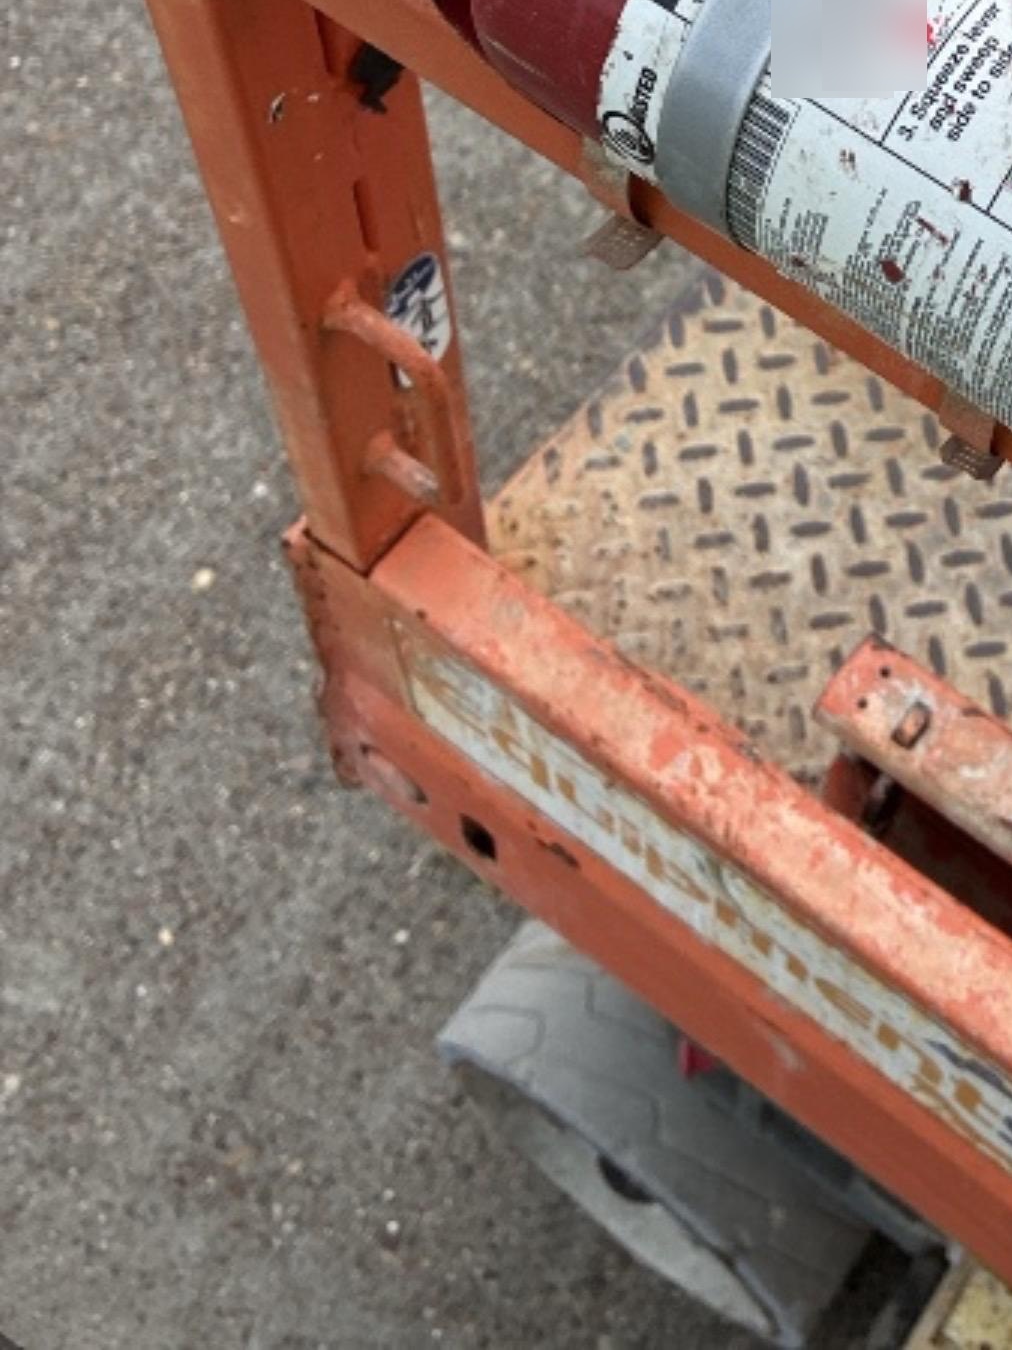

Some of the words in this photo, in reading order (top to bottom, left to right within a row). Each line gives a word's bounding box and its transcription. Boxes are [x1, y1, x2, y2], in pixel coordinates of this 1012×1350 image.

[895, 116, 919, 142] 3.
[908, 41, 974, 122] Squeeze
[963, 0, 1003, 44] lever
[925, 92, 959, 131] and
[951, 34, 1004, 96] sweep
[940, 98, 979, 142] side
[970, 69, 999, 102] to
